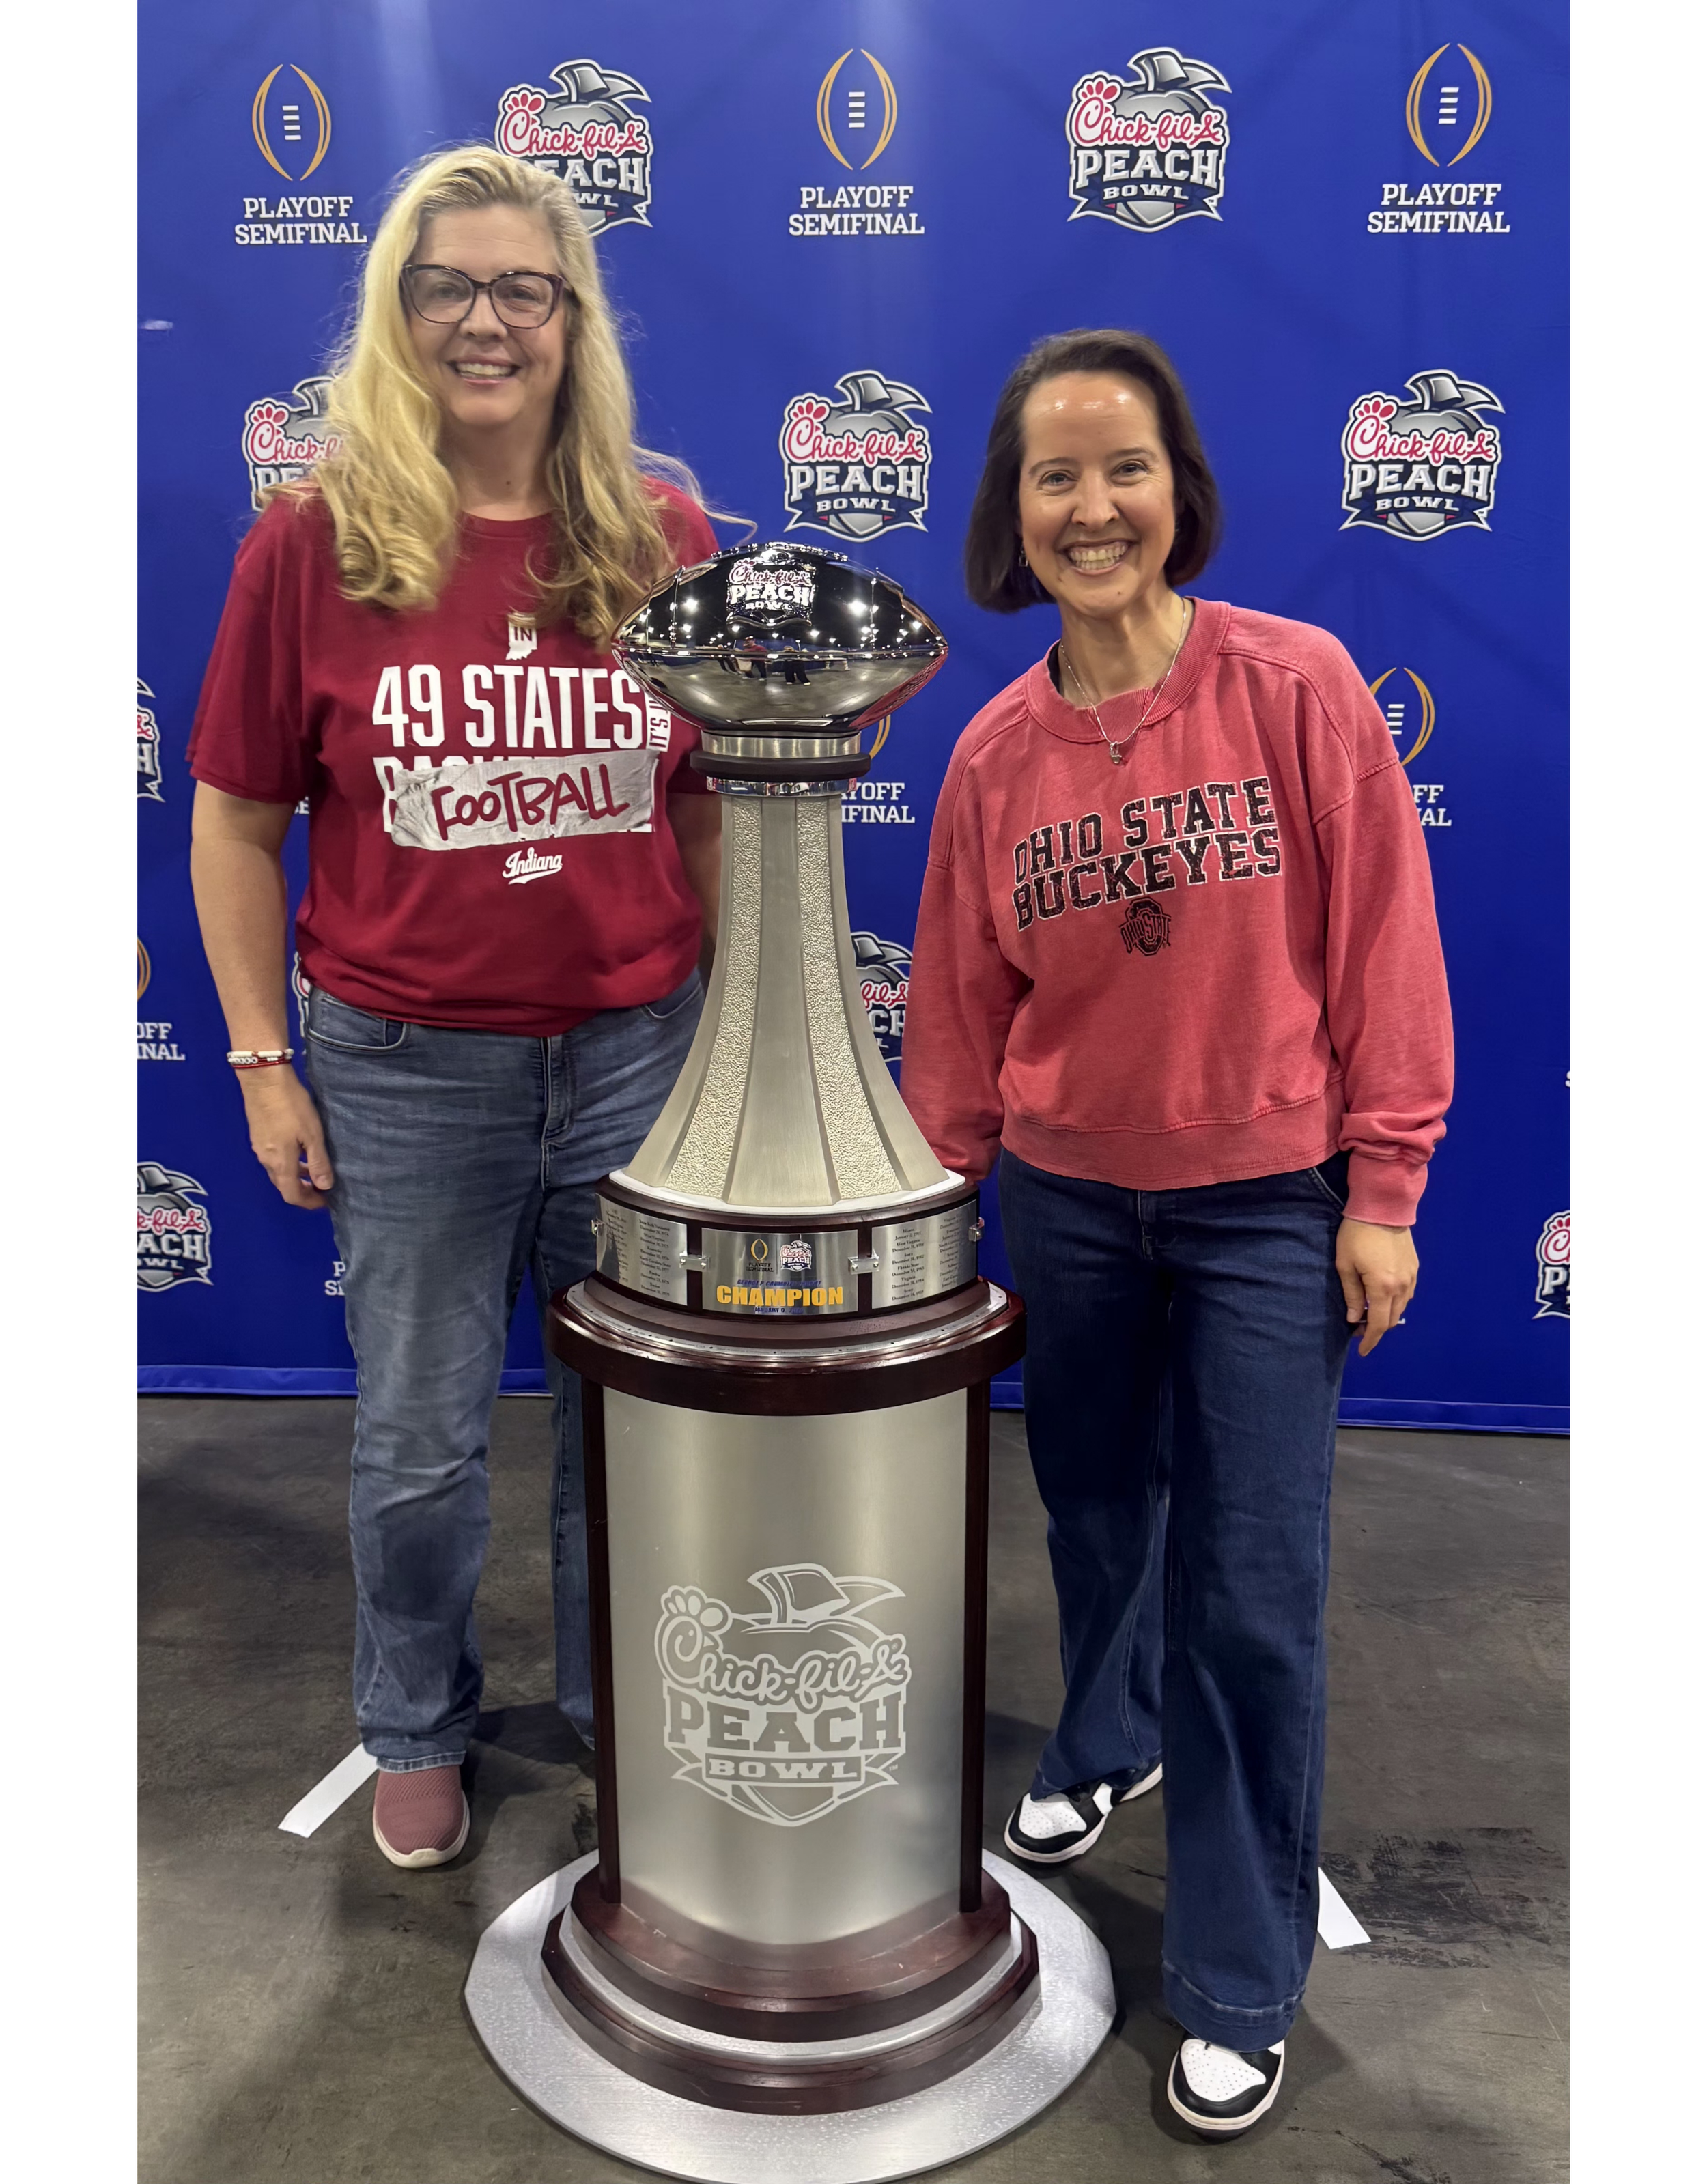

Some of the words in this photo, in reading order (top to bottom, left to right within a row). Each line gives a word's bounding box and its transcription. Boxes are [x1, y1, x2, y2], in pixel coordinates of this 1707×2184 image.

[504, 109, 646, 158] Chick-fil-A
[1075, 96, 1221, 148] Chick-fil-A
[1075, 150, 1219, 189] PEACH
[800, 186, 914, 208] PLAYOFF
[1103, 184, 1189, 200] BOWL
[1381, 183, 1502, 205] PLAYOFF
[243, 196, 354, 218] PLAYOFF
[234, 223, 367, 244] SEMIFINAL
[788, 213, 925, 236] SEMIFINAL
[1367, 211, 1510, 233] SEMIFINAL
[787, 416, 924, 465] Chick-fil-A
[1350, 415, 1493, 464] Chick-fil-A
[790, 465, 922, 502] PEACH
[1349, 464, 1491, 502] PEACH
[817, 498, 896, 513] BOWL
[1375, 496, 1459, 511] BOWL
[731, 584, 810, 606] PEACH
[513, 626, 533, 641] IN
[372, 664, 445, 747] 49
[462, 664, 643, 749] STATES
[432, 764, 630, 840] FOOTBALL
[841, 805, 915, 823] IFINAL
[1013, 812, 1103, 886] OHIO
[1121, 776, 1278, 849] STATE
[503, 847, 563, 879] Indiana
[1012, 827, 1282, 932] BUCKEYES
[137, 1234, 206, 1262] ACH
[717, 1285, 843, 1307] CHAMPION
[662, 1616, 904, 1709] Chick-fil-A
[667, 1686, 902, 1753] PEACH
[709, 1760, 858, 1779] BOWL
